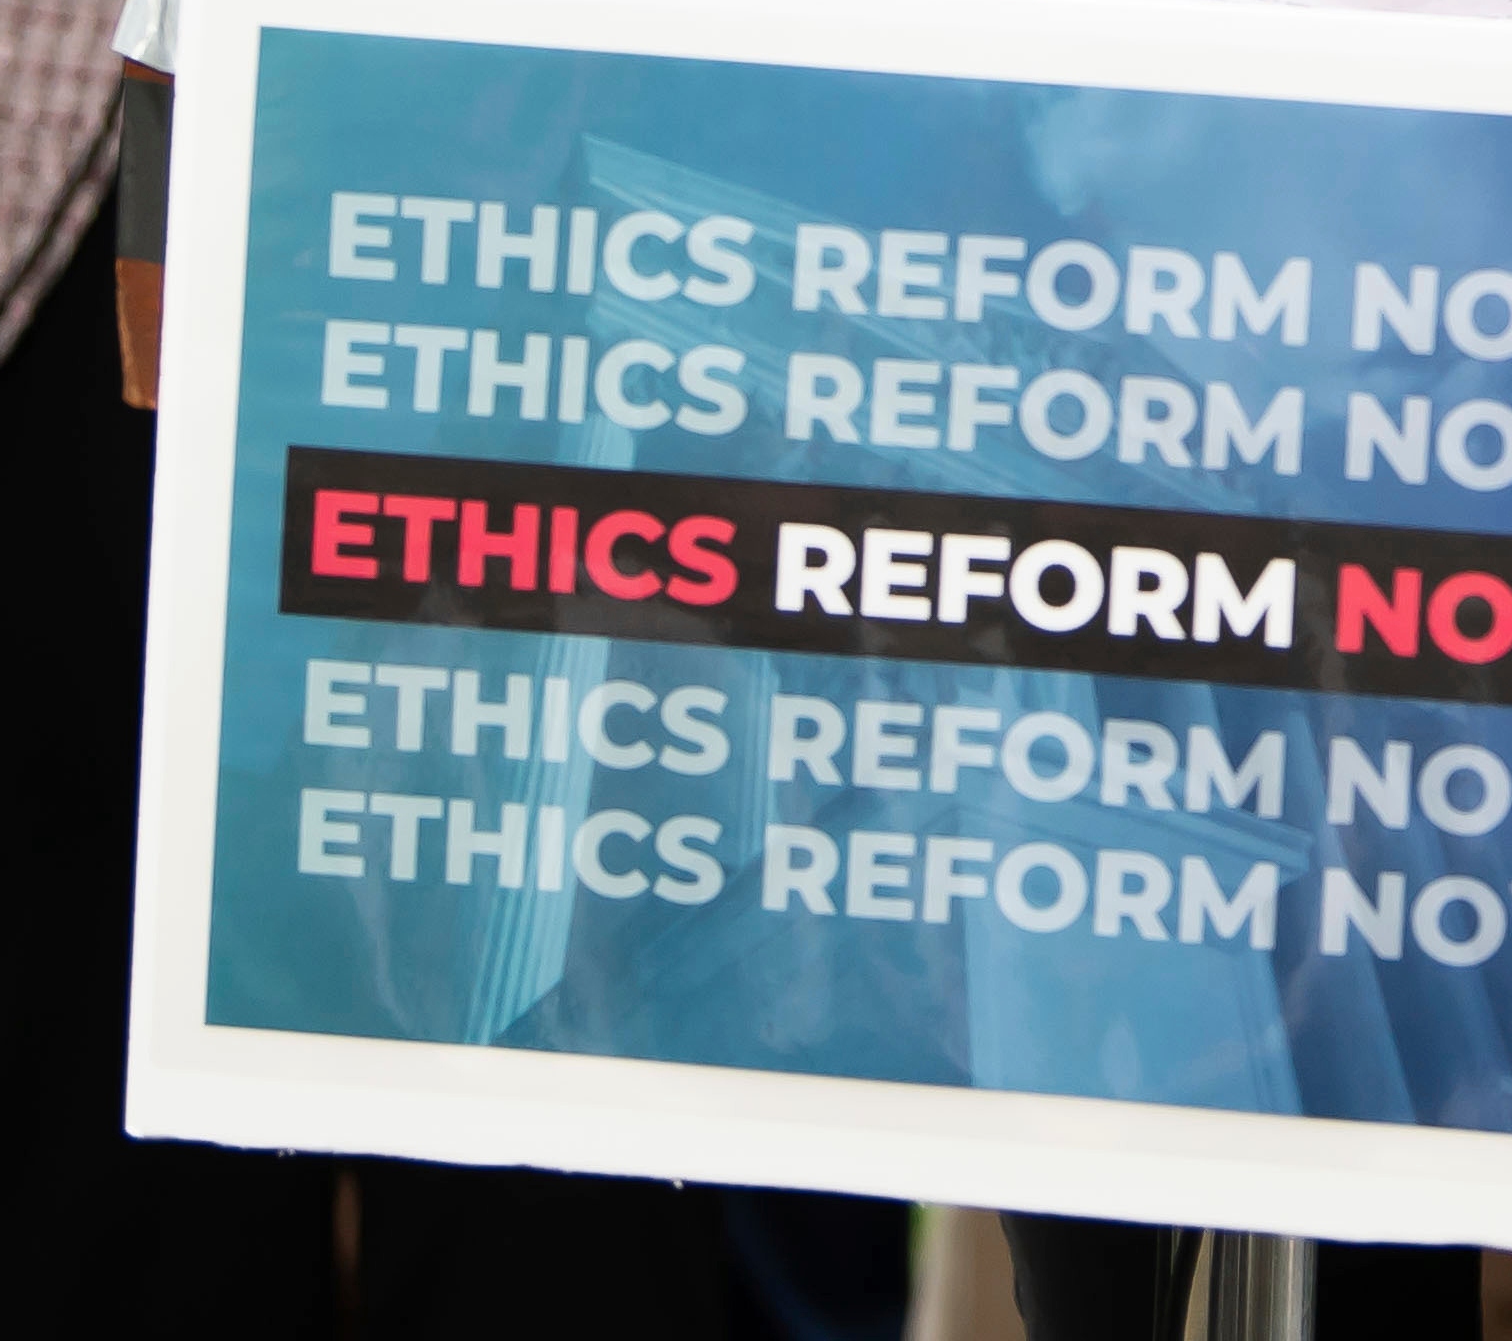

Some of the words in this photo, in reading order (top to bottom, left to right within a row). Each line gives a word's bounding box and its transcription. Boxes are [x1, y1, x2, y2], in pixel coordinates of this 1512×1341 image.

[330, 191, 756, 307] ETHICS
[792, 223, 1313, 347] REFORM
[321, 319, 748, 435] ETHICS
[785, 351, 1306, 476] REFORM
[310, 489, 739, 606] ETHICS
[774, 523, 1297, 649] REFORM
[304, 660, 730, 775] ETHICS
[767, 694, 1285, 817] REFORM
[299, 788, 723, 903] ETHICS
[762, 822, 1278, 949] REFORM
